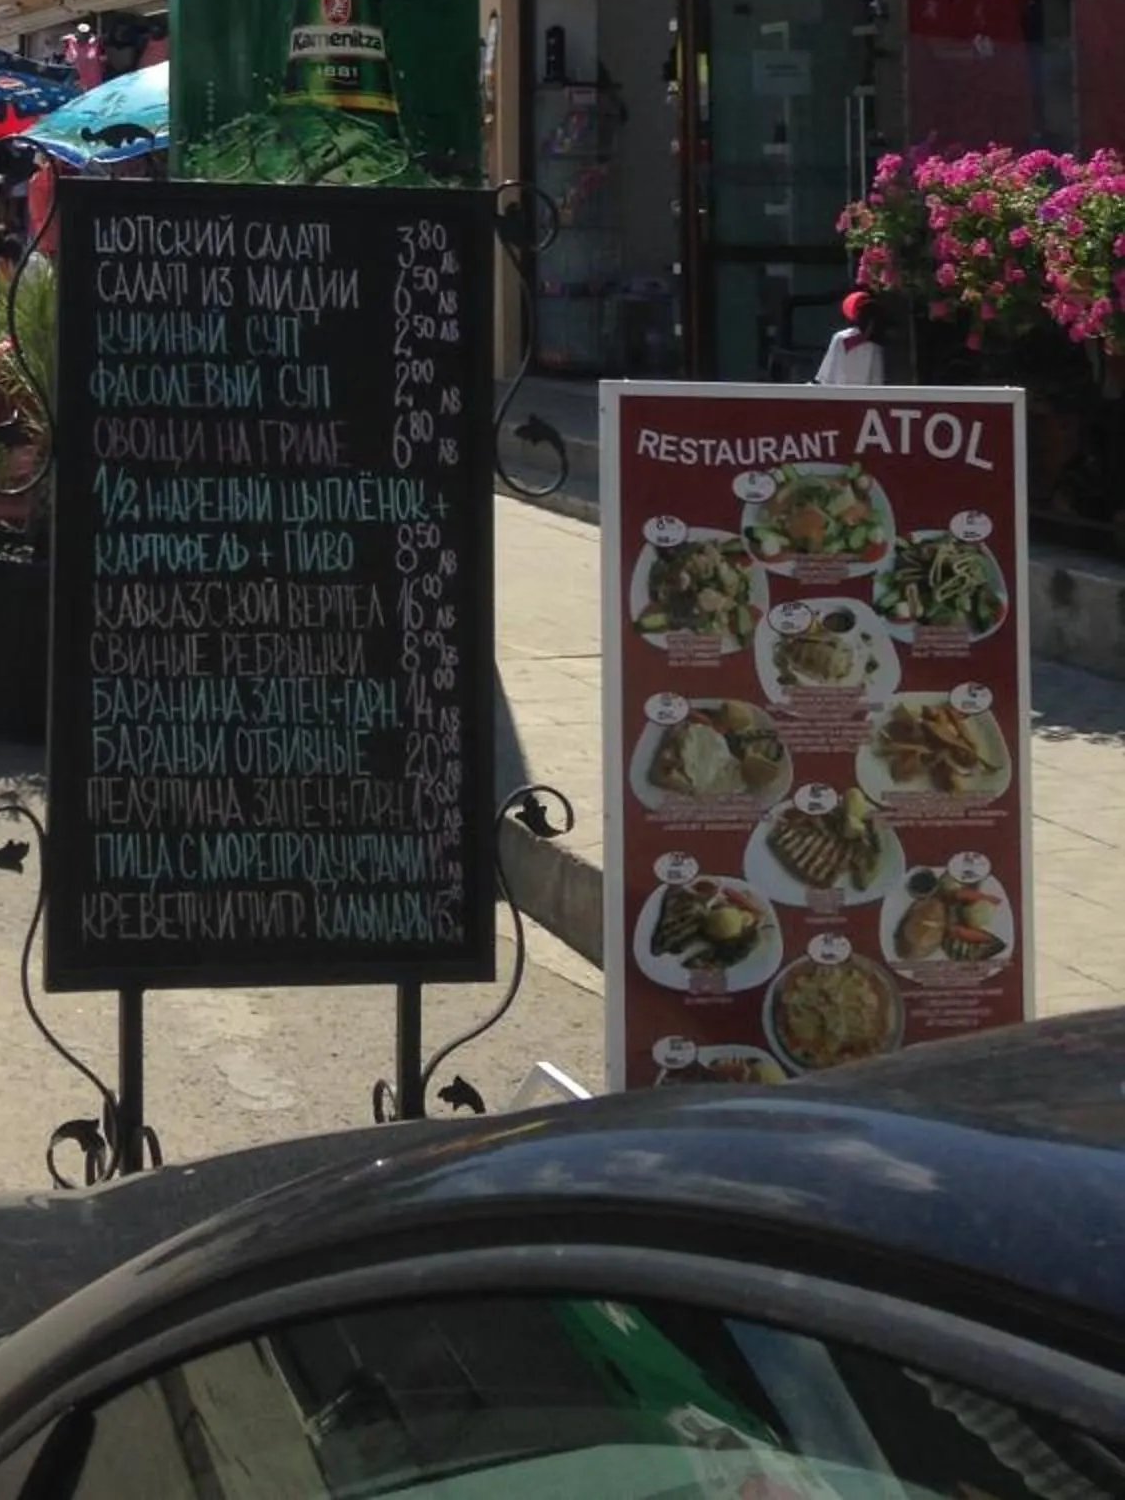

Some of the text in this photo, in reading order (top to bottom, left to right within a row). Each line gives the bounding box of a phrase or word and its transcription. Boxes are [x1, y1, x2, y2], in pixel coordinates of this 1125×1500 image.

[201, 266, 234, 307] ИЗ
[278, 364, 331, 411] СУП
[637, 408, 994, 471] RESTAURANT ATOL
